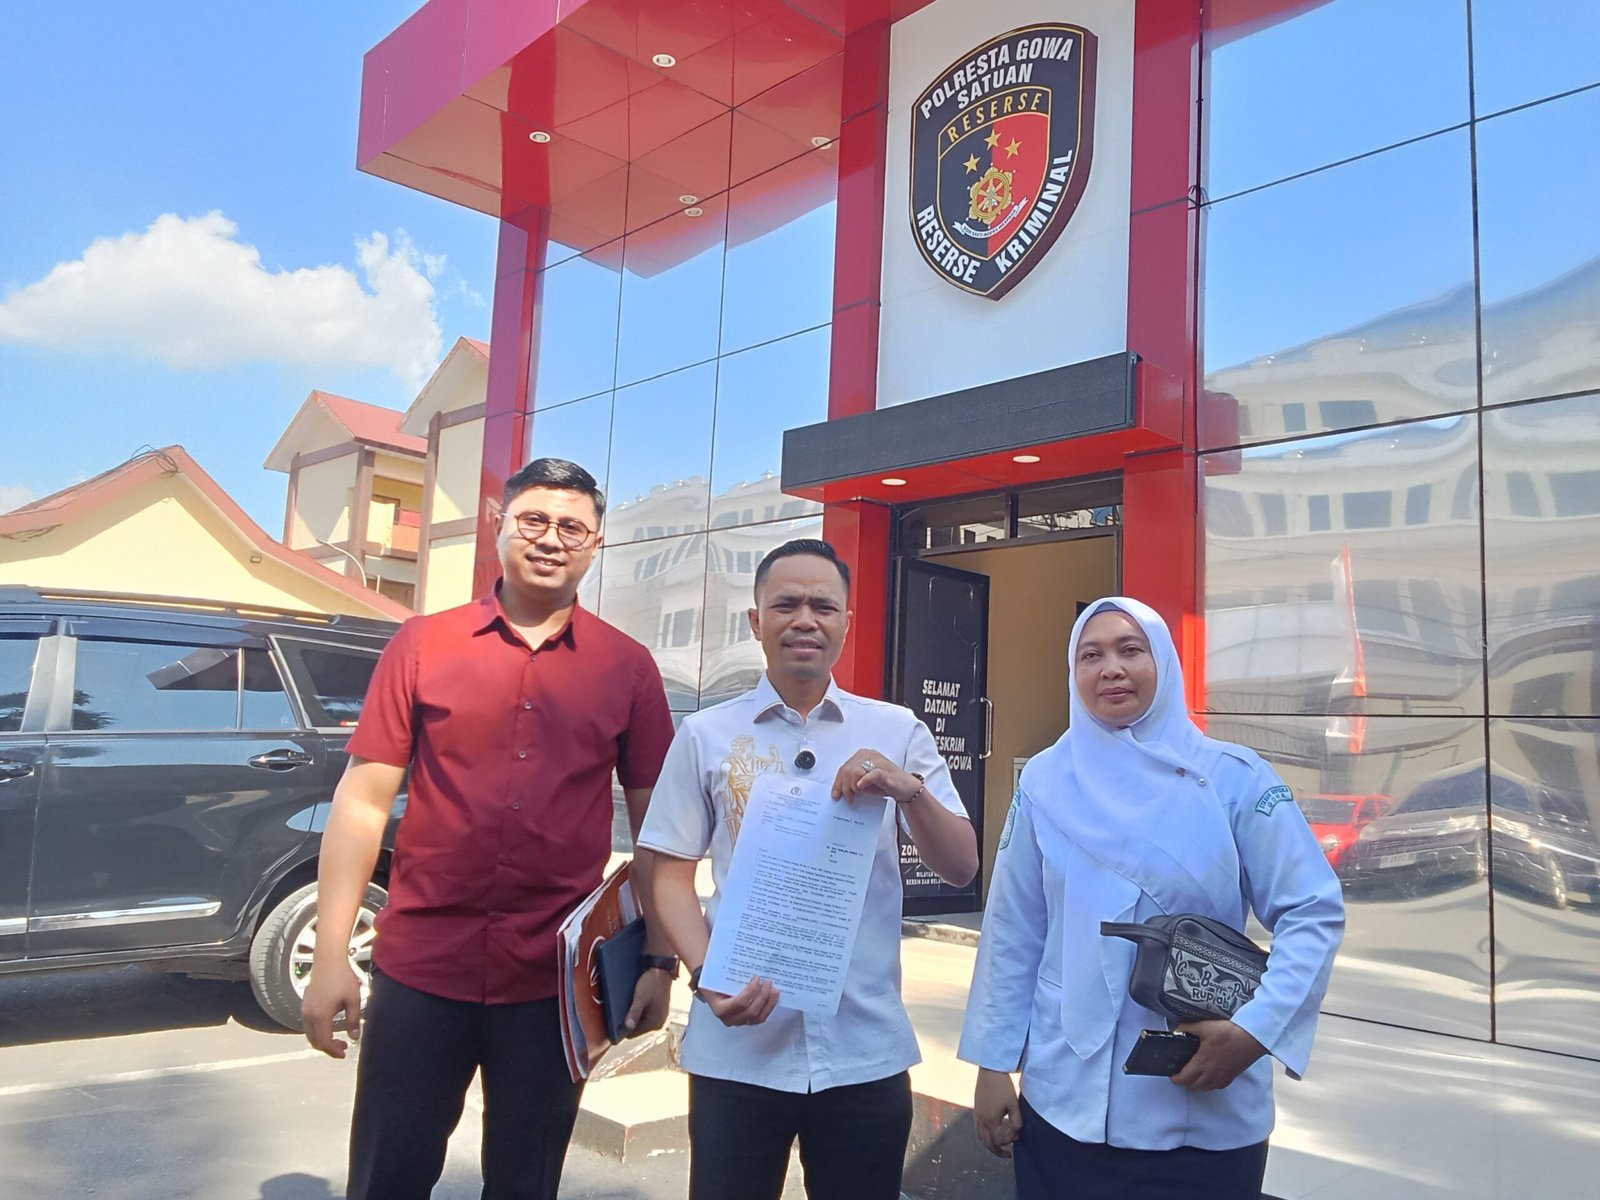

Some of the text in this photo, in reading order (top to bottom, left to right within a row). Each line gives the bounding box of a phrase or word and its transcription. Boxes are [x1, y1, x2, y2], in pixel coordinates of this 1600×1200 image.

[920, 37, 1073, 119] POLRESTA GOWA
[958, 63, 1033, 110] SATUAN
[947, 92, 1042, 143] RESERSE
[917, 150, 1073, 284] RESERSE KRIMINAL
[922, 679, 960, 698] SELAMAT
[924, 698, 957, 716] DATANG
[935, 717, 945, 733] DI
[935, 735, 965, 752] ESKRIM
[948, 755, 972, 771] GOWA
[901, 844, 918, 856] ZON
